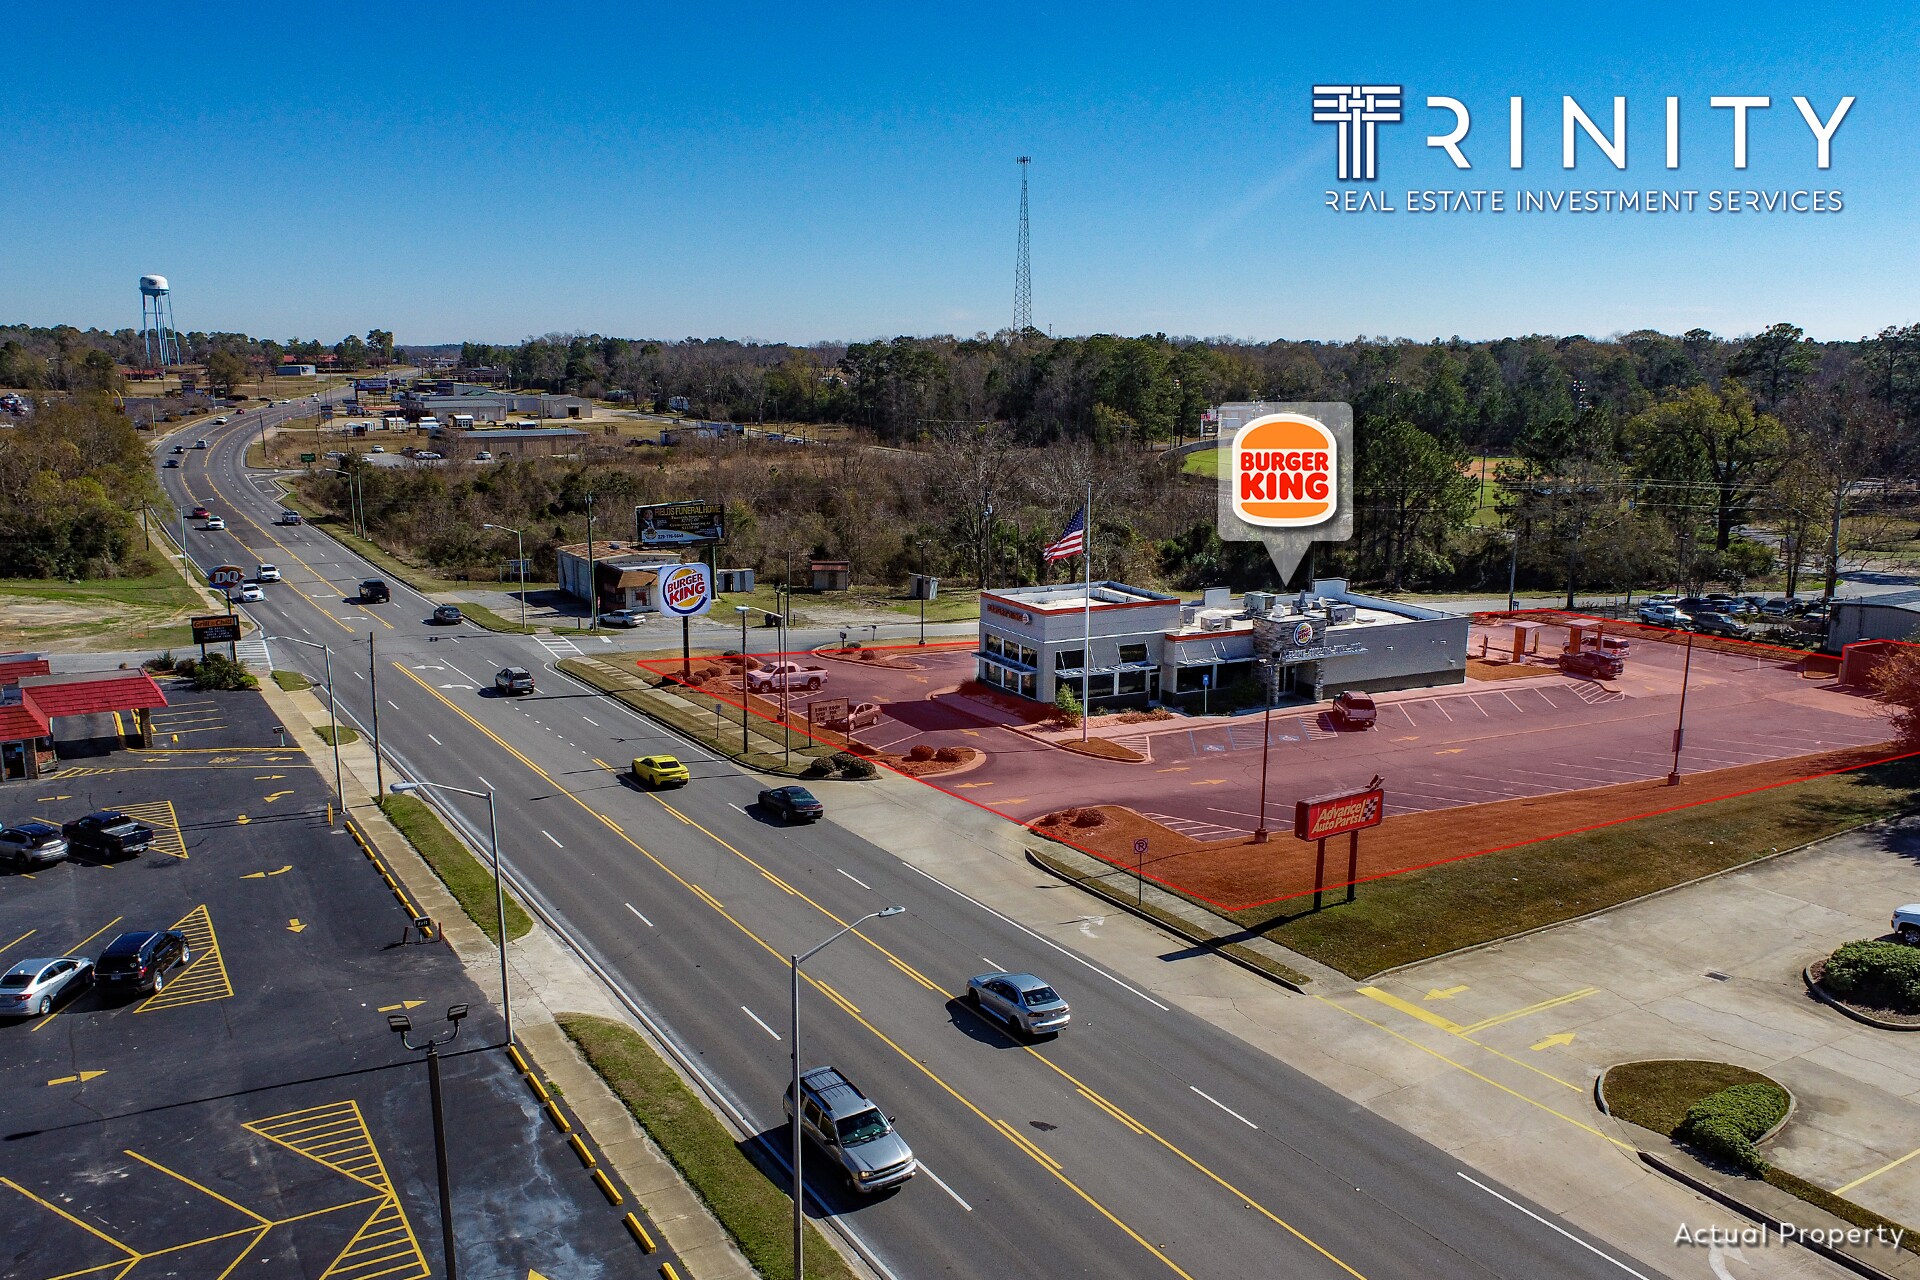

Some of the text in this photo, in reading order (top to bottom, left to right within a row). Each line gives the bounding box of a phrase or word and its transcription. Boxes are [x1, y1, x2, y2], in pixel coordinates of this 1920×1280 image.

[214, 570, 239, 584] DQ
[667, 573, 703, 593] BURGER
[669, 582, 705, 606] KING
[193, 620, 210, 628] Grill
[1318, 803, 1362, 822] Advance
[1311, 815, 1361, 834] Auto Parts
